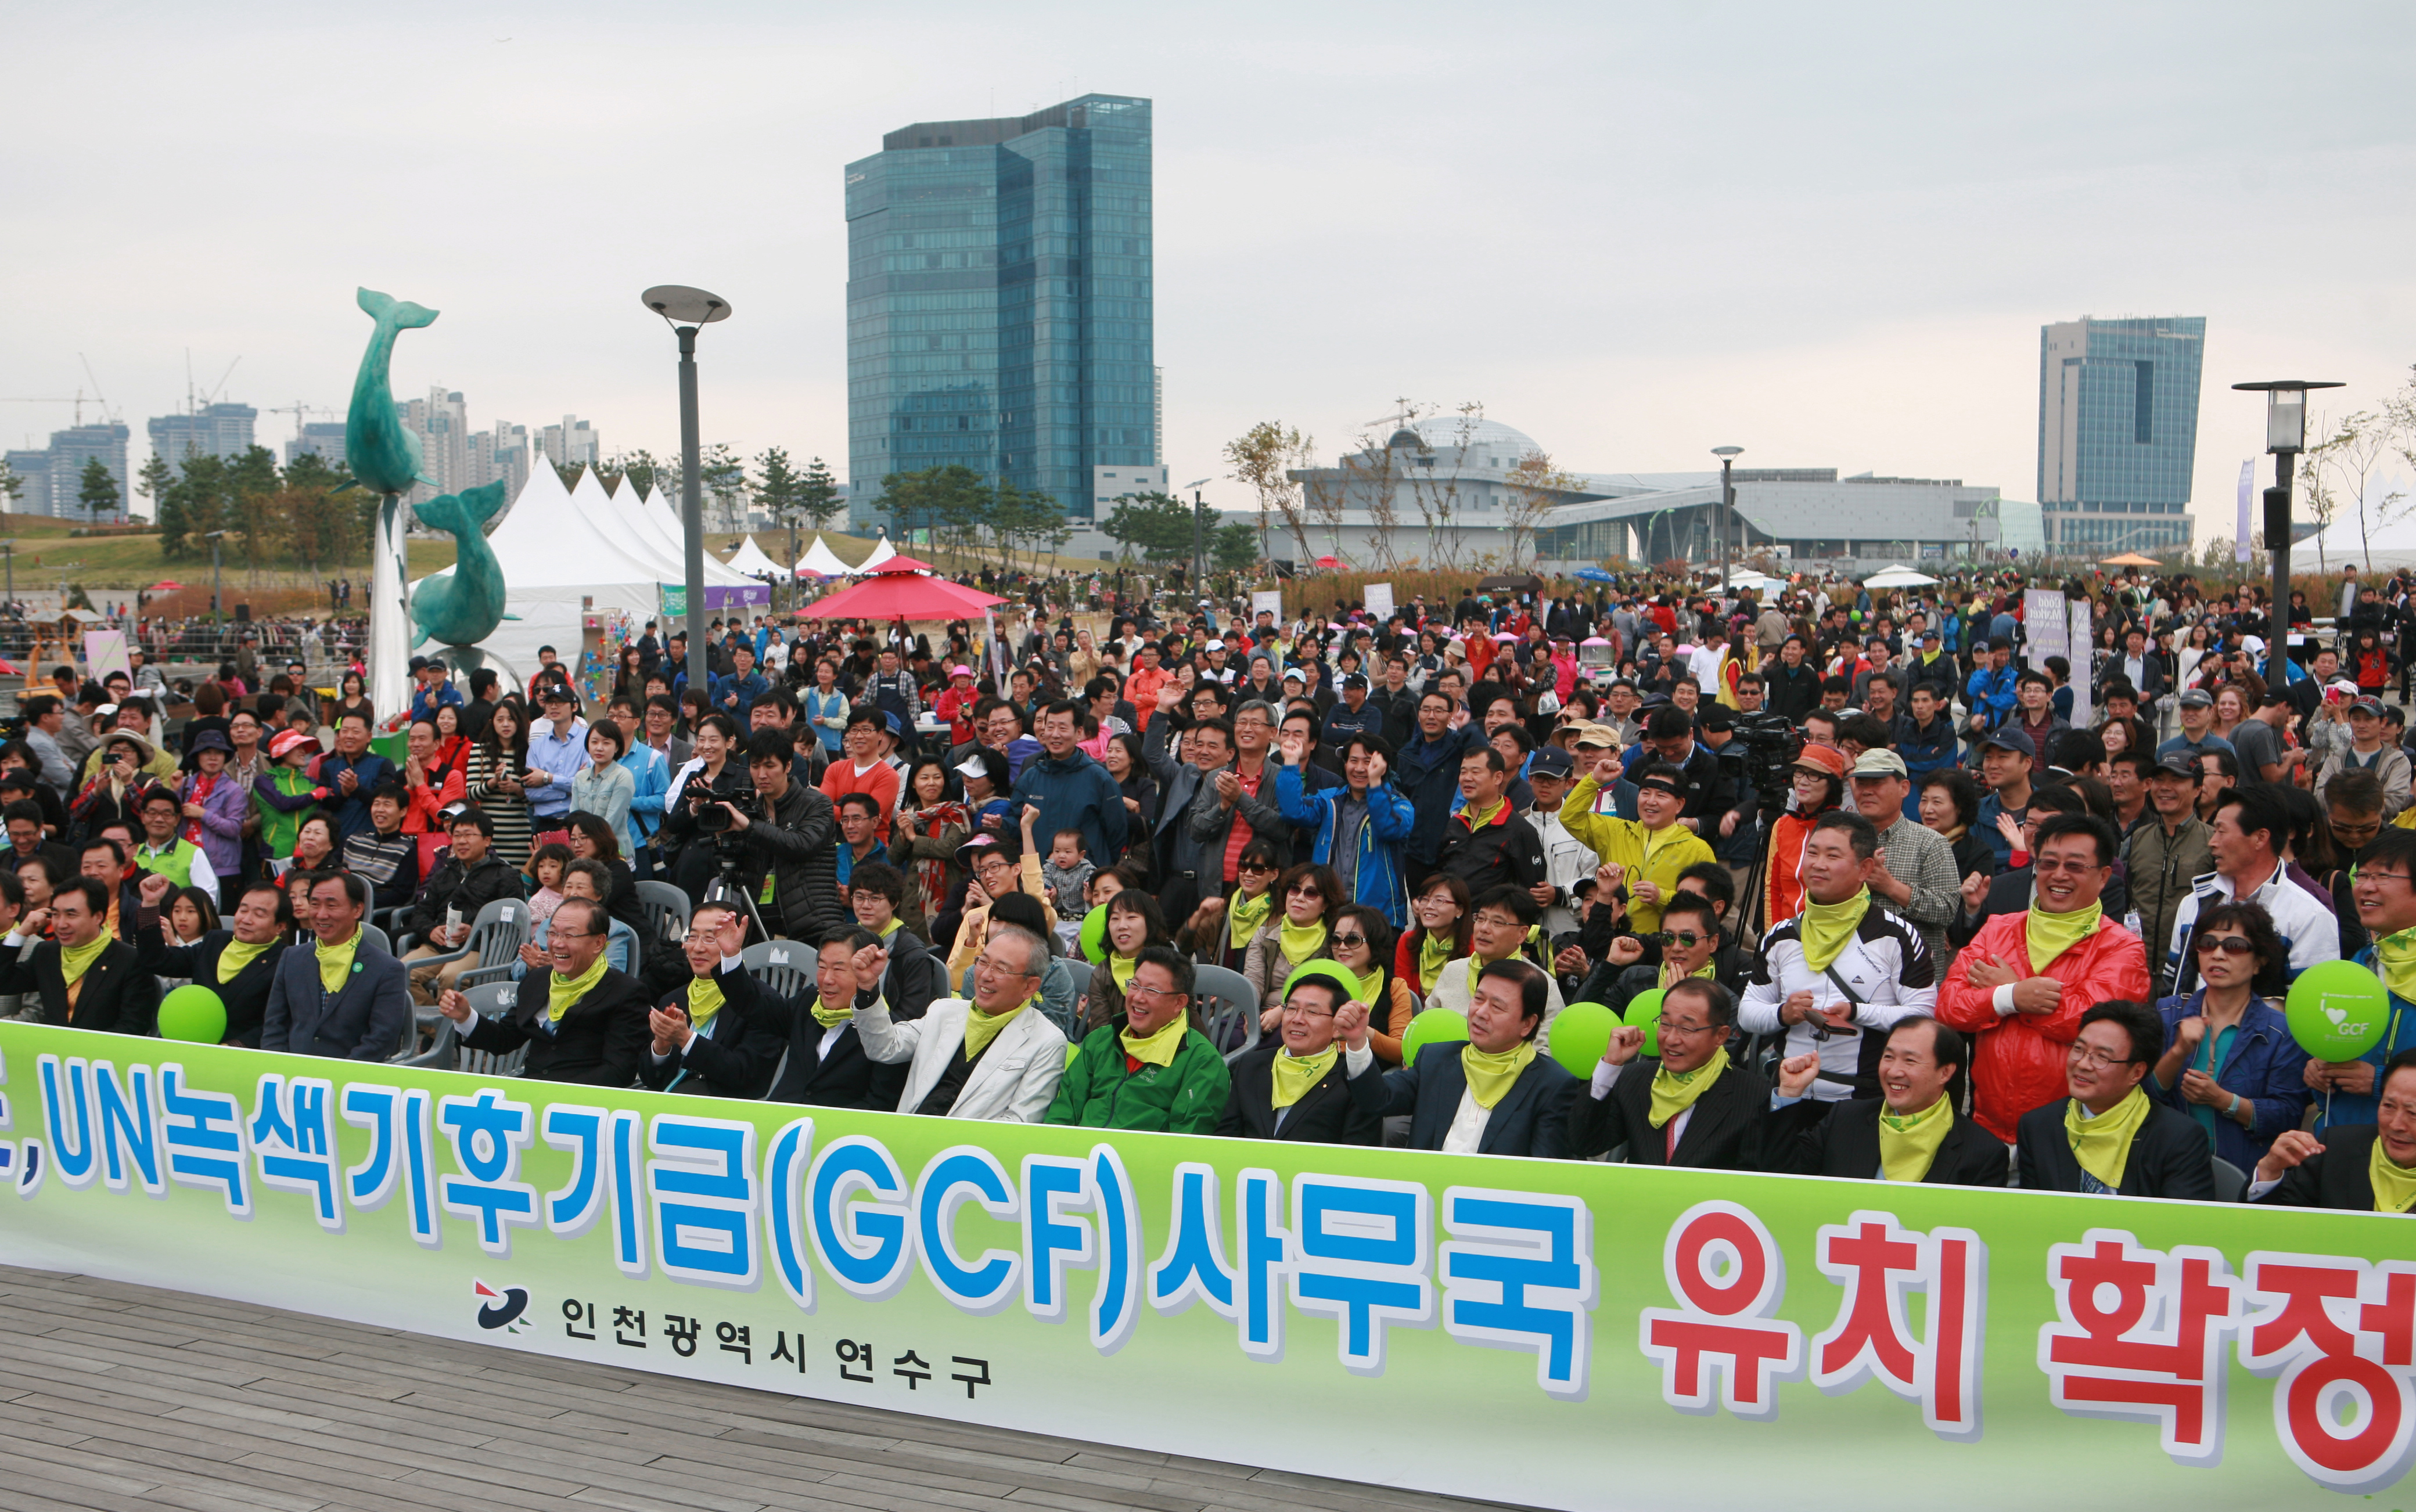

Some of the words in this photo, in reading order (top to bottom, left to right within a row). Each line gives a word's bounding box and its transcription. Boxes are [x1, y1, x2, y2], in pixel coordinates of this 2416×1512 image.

[2353, 696, 2376, 705] USA
[2338, 1022, 2370, 1035] GCF
[562, 1298, 806, 1374] 인천광역시
[835, 1337, 992, 1399] 연수구
[1648, 1209, 1970, 1425] 유치
[2048, 1237, 2416, 1474] 확정
